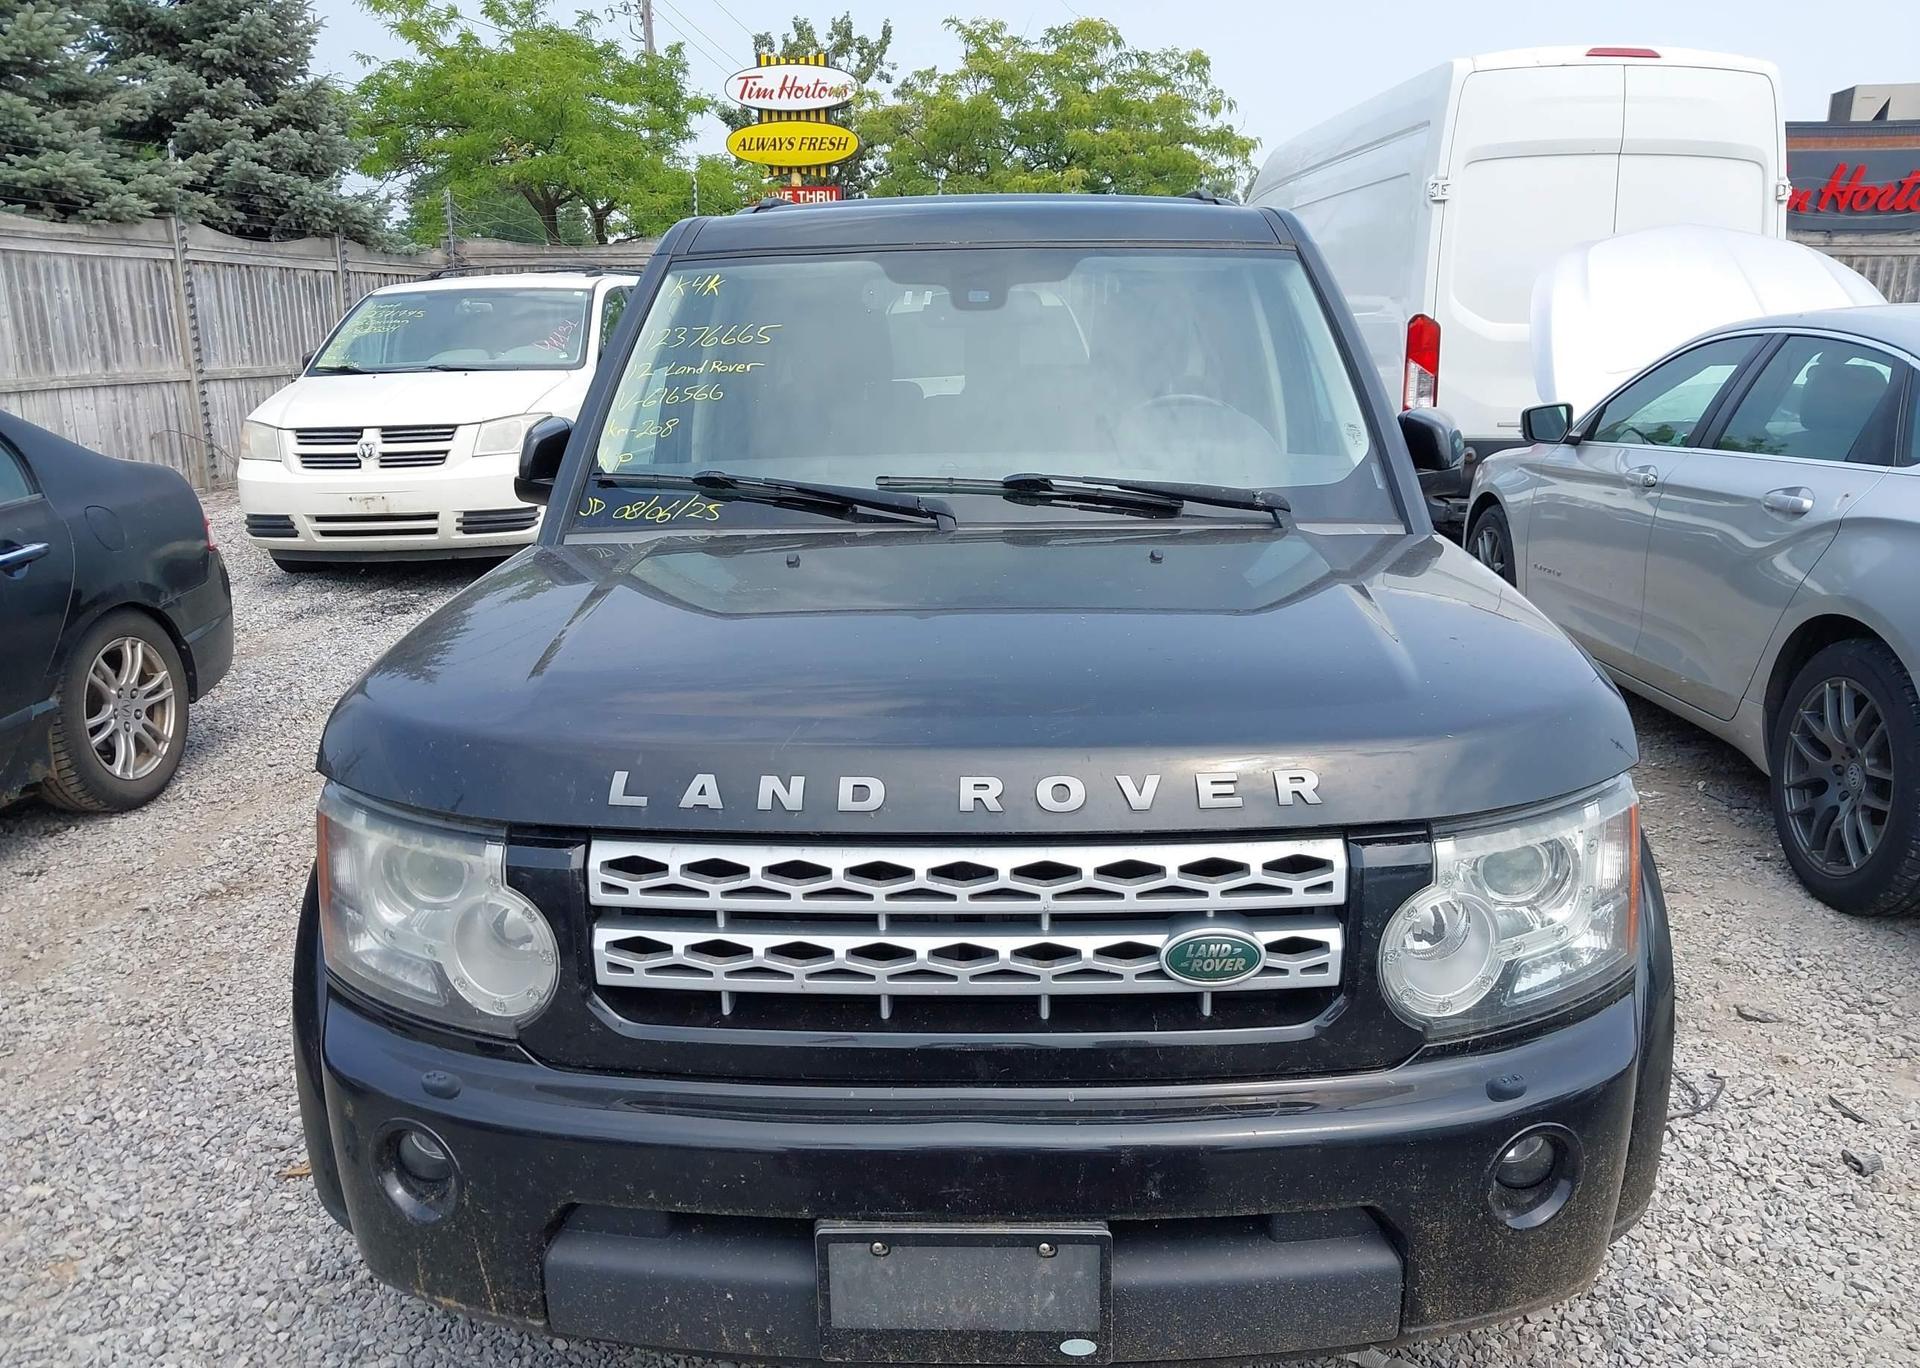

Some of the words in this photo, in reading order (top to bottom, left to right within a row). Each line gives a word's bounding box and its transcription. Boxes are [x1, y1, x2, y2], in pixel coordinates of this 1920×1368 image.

[737, 75, 775, 100] Tim
[737, 136, 796, 151] ALWAYS
[799, 136, 849, 151] FRESH
[797, 190, 836, 203] THRU
[645, 323, 783, 351] 12376665
[629, 362, 653, 380] 12
[664, 359, 708, 376] Land
[709, 360, 765, 373] Rover
[579, 497, 606, 516] JD
[612, 494, 724, 523] 08/06/25
[608, 770, 886, 812] LAND
[959, 769, 1323, 812] ROVER
[1186, 943, 1232, 958] LAND
[1190, 958, 1247, 972] ROVER
